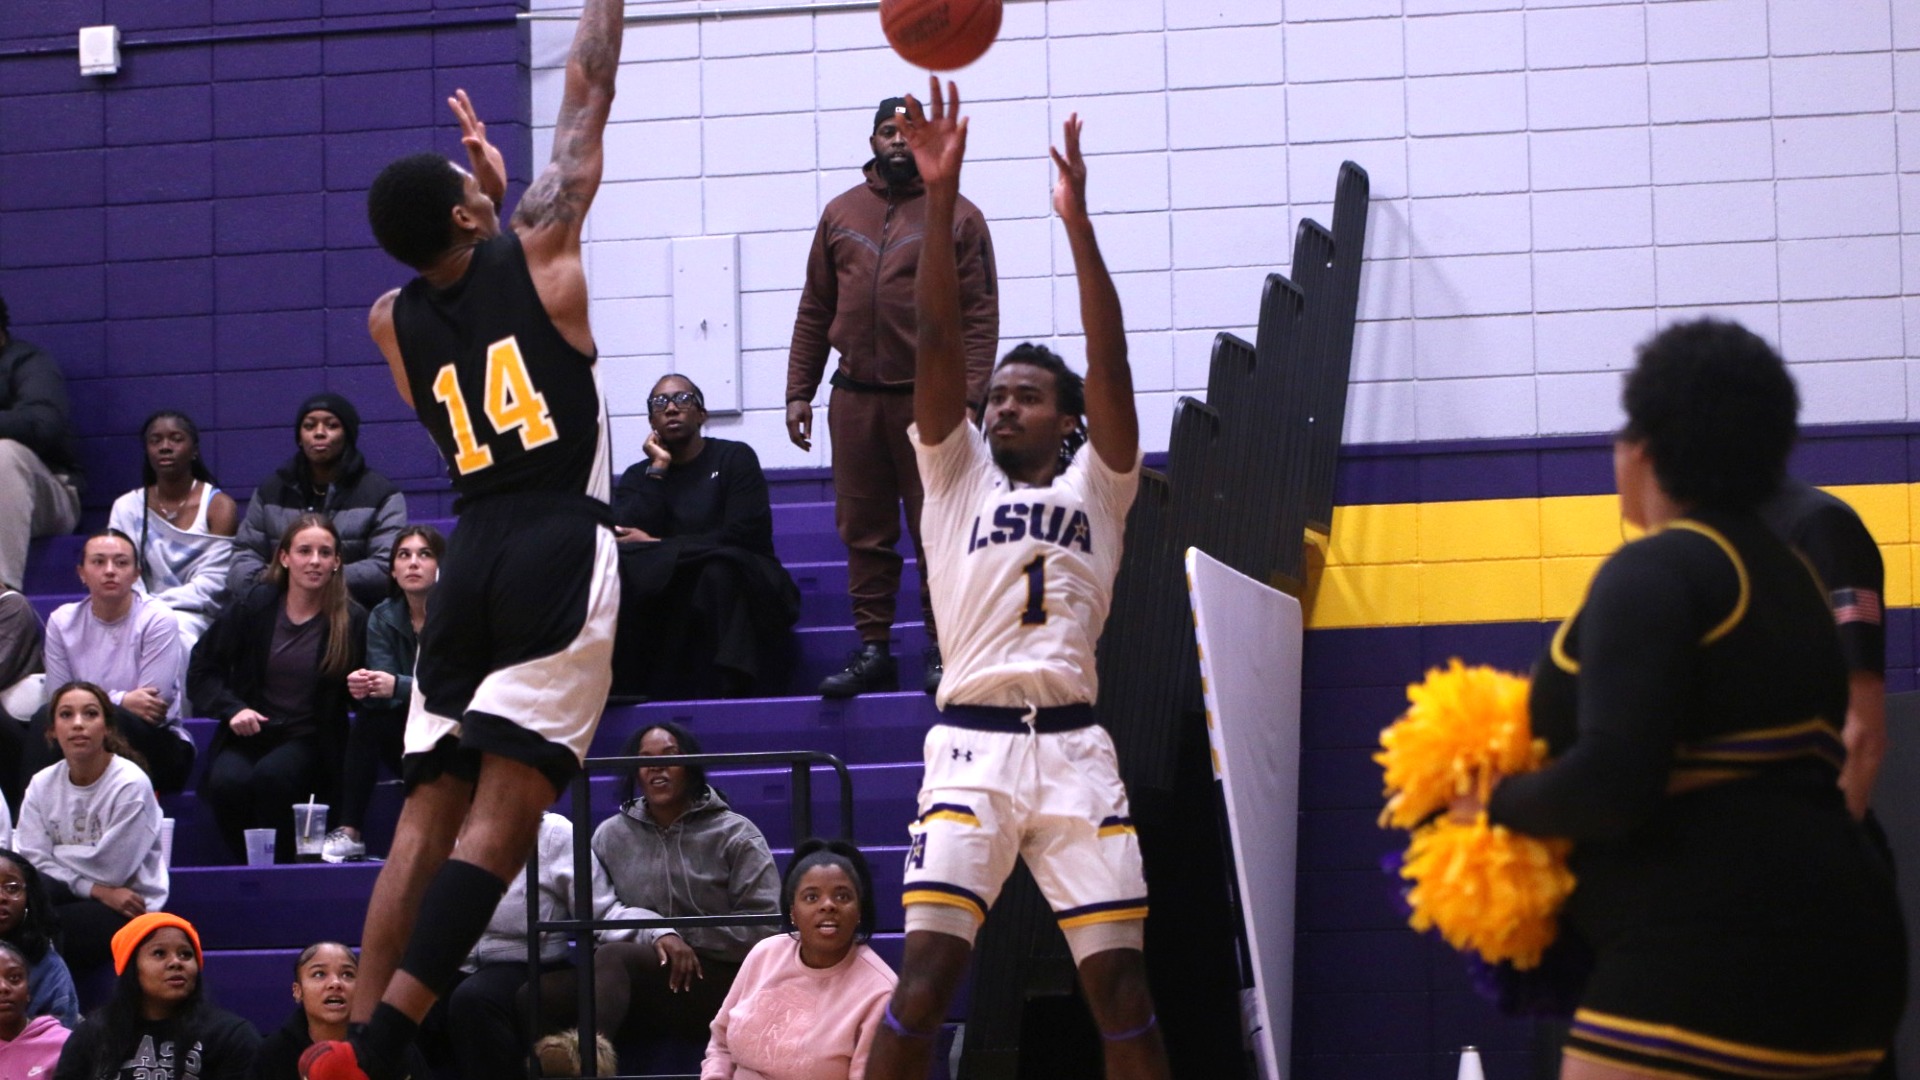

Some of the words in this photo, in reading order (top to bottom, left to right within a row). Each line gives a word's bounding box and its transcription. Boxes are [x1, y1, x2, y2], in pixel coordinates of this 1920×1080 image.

[432, 335, 559, 475] 14
[968, 503, 1093, 555] LSUA
[1021, 553, 1047, 626] 1
